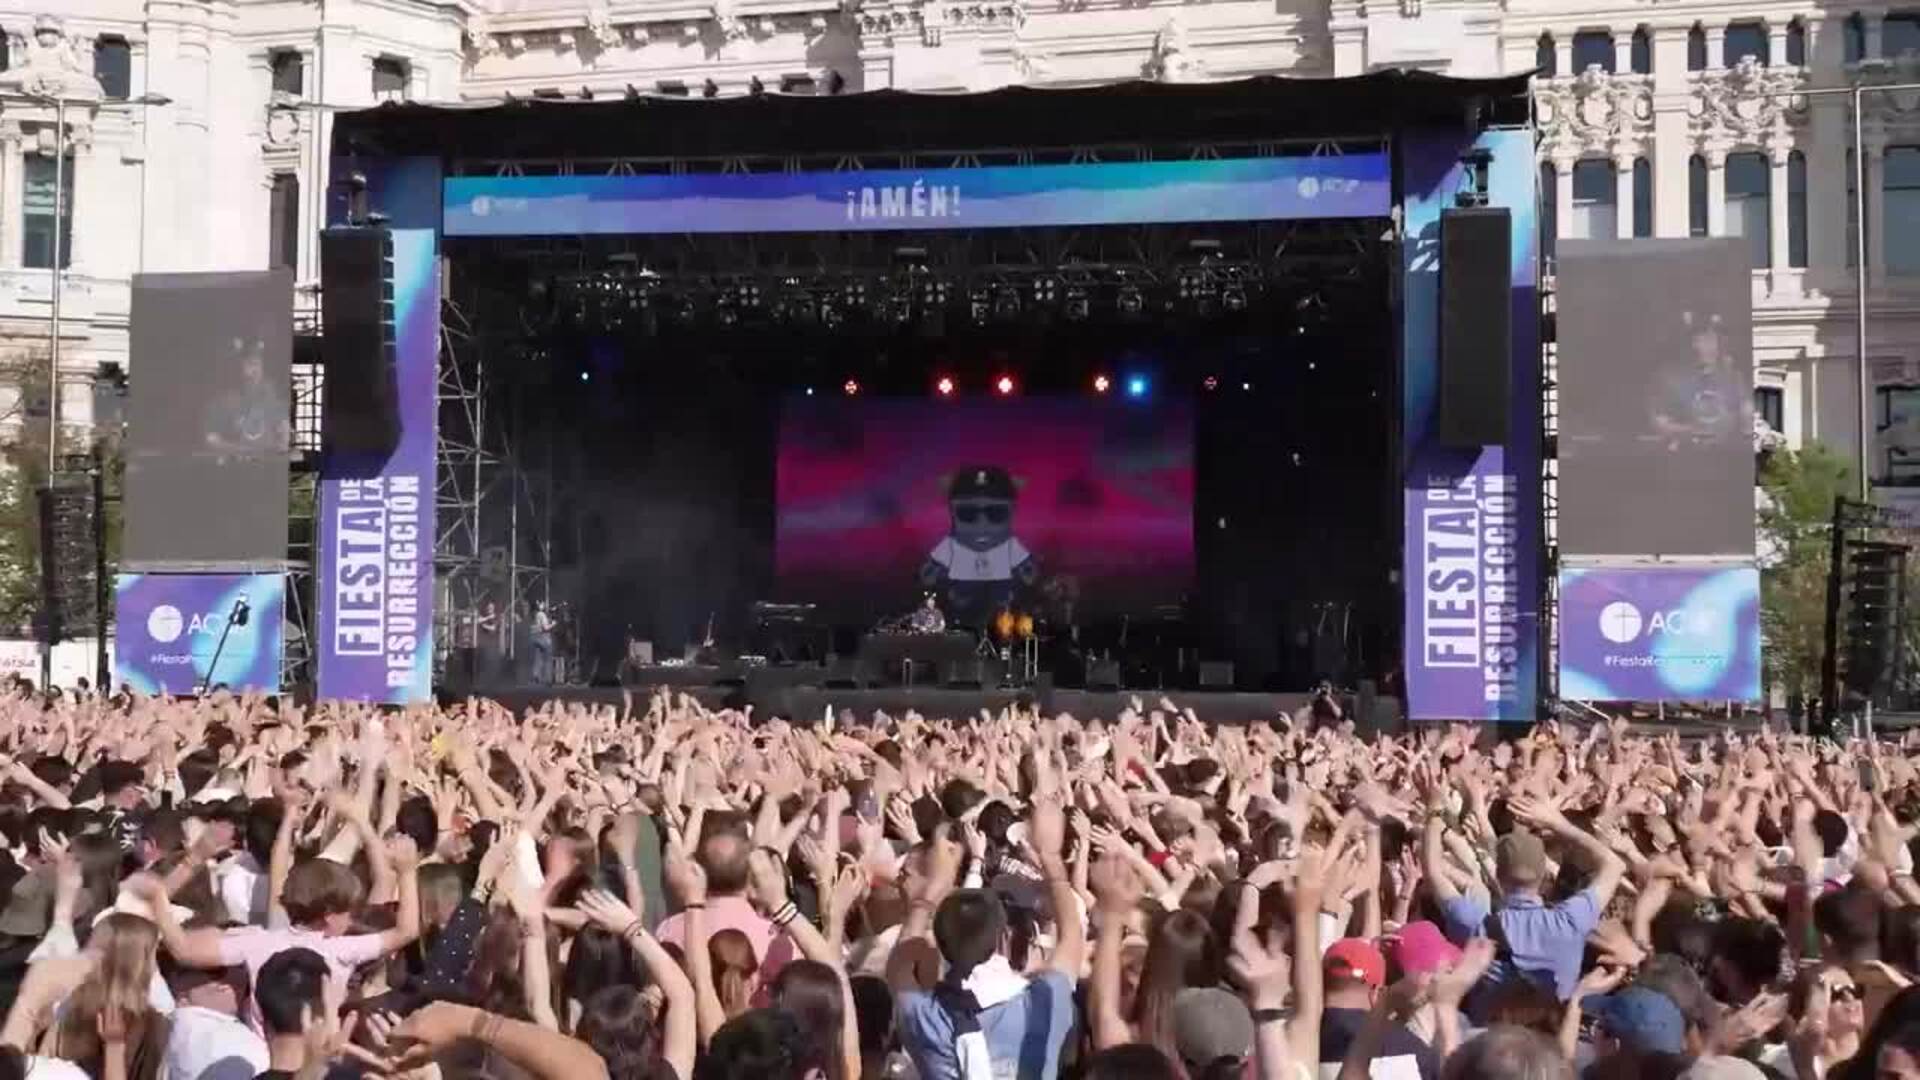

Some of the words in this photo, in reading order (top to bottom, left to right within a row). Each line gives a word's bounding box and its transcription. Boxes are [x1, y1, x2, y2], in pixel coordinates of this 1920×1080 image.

[846, 176, 961, 220] ¡AMÉN!
[340, 478, 361, 501] DE
[363, 475, 385, 501] LA
[1427, 474, 1450, 501] DE
[1452, 475, 1477, 501] LA
[338, 511, 384, 652] FIESTA
[384, 475, 420, 687] RESURRECCIÓN
[1427, 512, 1477, 664] FIESTA
[1478, 475, 1518, 702] RESURRECCIÓN
